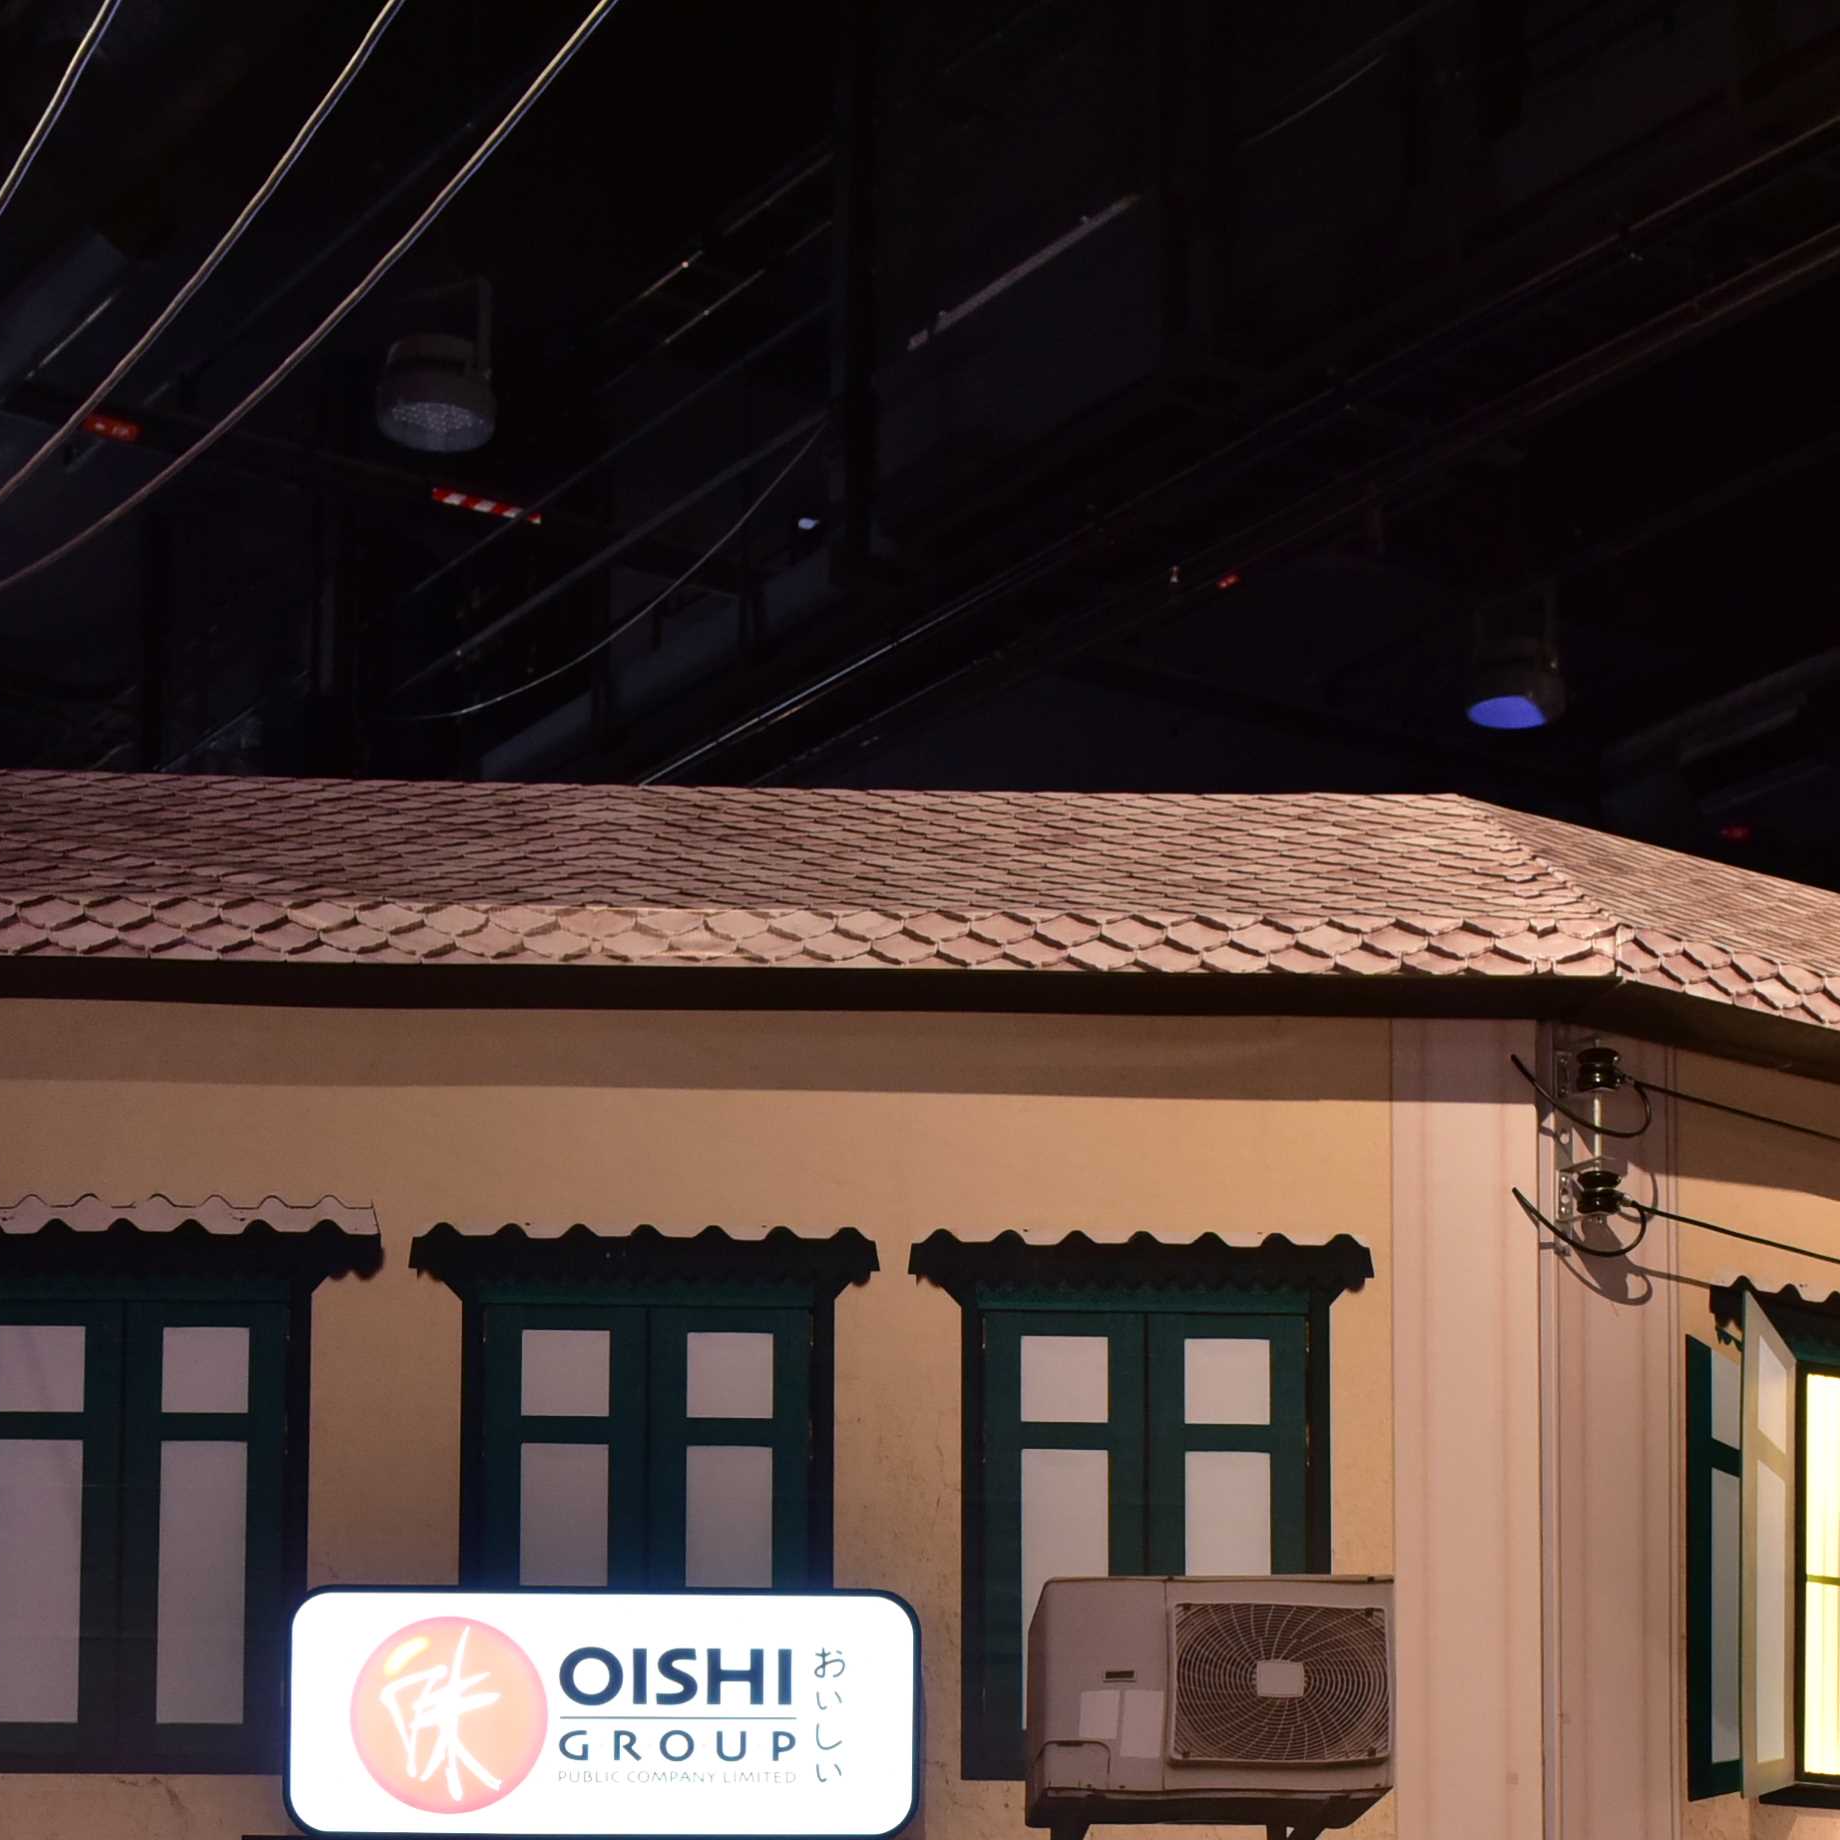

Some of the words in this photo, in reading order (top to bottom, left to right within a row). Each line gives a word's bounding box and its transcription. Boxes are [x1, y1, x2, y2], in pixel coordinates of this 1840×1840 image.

[558, 1645, 793, 1706] OISHI
[813, 1646, 846, 1783] おいしい
[558, 1729, 797, 1762] GROUP
[557, 1770, 620, 1784] PUBLIC
[626, 1770, 716, 1784] COMPANY
[722, 1770, 797, 1784] LIMITED
